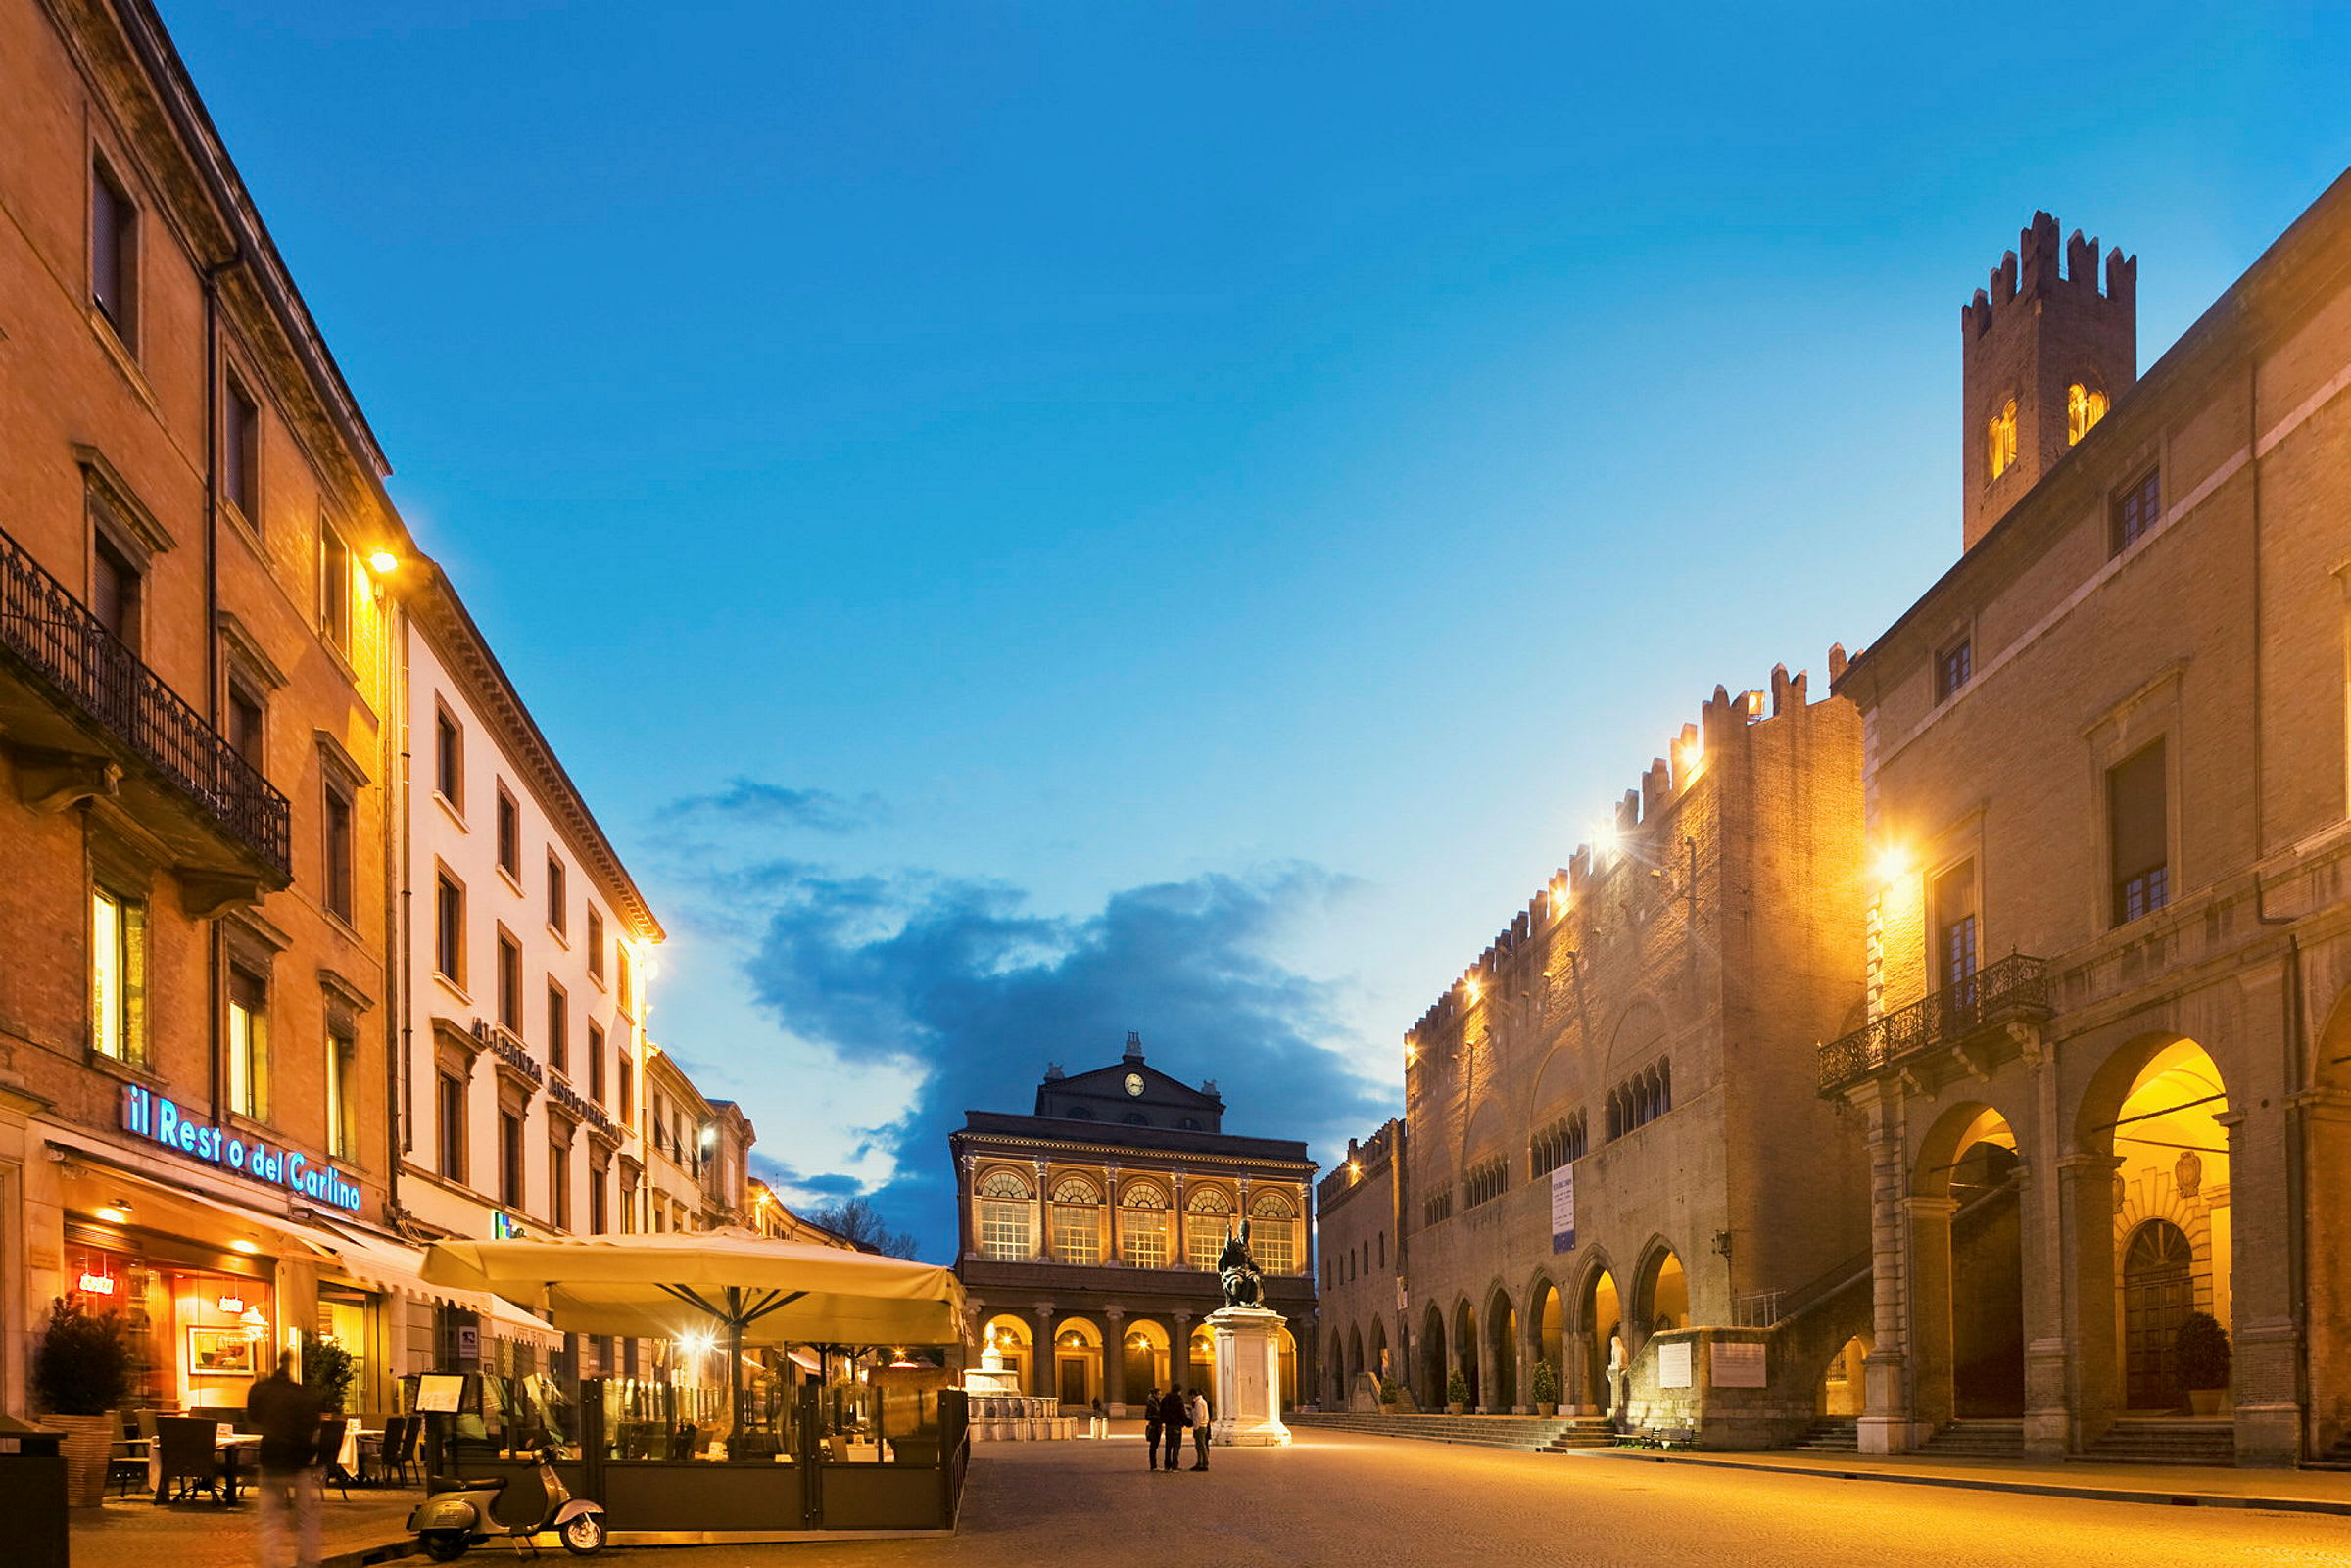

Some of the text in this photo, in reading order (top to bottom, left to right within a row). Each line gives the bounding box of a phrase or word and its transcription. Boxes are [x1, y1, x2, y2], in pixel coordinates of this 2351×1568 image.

[470, 1017, 543, 1085] ALLEANZA
[130, 1084, 150, 1135] il
[251, 1144, 283, 1184] del
[288, 1152, 360, 1211] Carlino
